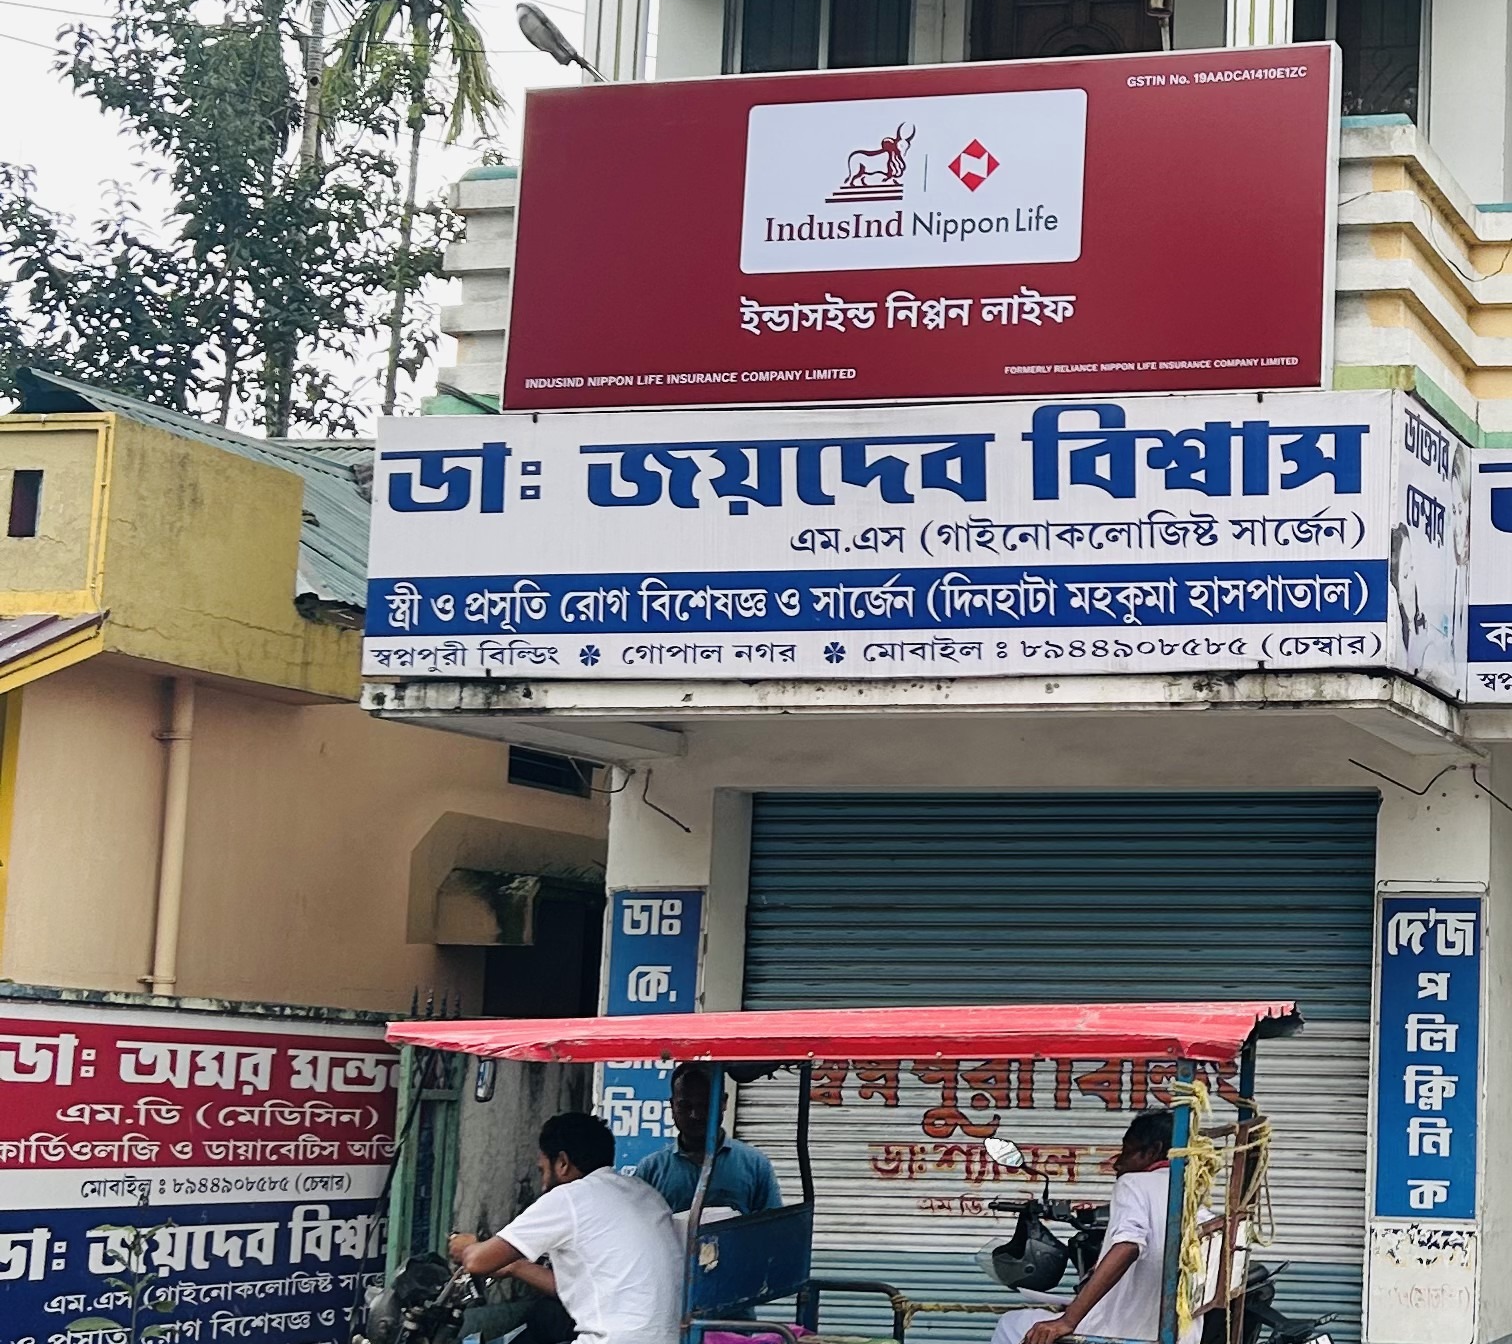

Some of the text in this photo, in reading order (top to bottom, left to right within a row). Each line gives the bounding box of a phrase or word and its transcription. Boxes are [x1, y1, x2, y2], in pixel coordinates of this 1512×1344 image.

[1127, 66, 1308, 88] GSTIN No. 19AADCA1410E1ZC
[764, 205, 1059, 243] IndusInd Nippon Life
[739, 285, 1077, 335] ইন্ডাসইন্ড নিপ্পন লাইফ
[525, 368, 857, 389] INDUSIND NIPPON LIFE INSURANCE COMPANY LIMITED
[1004, 356, 1299, 375] FORMERLY RELIANCE NIPPON LIFE INSURANCE COMPANY LIMITED
[579, 432, 995, 516] জয়দেব
[1022, 403, 1370, 501] বিশ্বাস
[1404, 407, 1450, 482] ডাক্তার
[1231, 505, 1366, 551] সার্জেন)
[1407, 484, 1446, 549] চেম্বার
[385, 571, 1370, 633] স্ত্রী ও প্রসূতি রোগ বিশেষজ্ঞ ও সার্জেন (দিনহাটা মহকুমা হাসপাতাল)
[370, 640, 467, 673] স্বপ্নপুরী
[476, 639, 559, 666] বিল্ডিং
[622, 641, 724, 665] গোপাল
[734, 642, 796, 664] নগর
[863, 634, 982, 664] মোবাইল
[1020, 637, 1248, 661] ৮৯৪৪৯০৮৫৮৫
[1262, 631, 1383, 661] (চেম্বার)
[116, 1041, 277, 1095] অমর
[288, 1049, 400, 1092] মন্ড
[170, 1141, 193, 1159] ও
[202, 1134, 340, 1161] ডায়াবেটিস
[173, 1176, 291, 1195] ৮৯৪৪৯০৮৫৮৫
[209, 1310, 311, 1341] বিশেষজ্ঞ
[317, 1309, 336, 1326] ও
